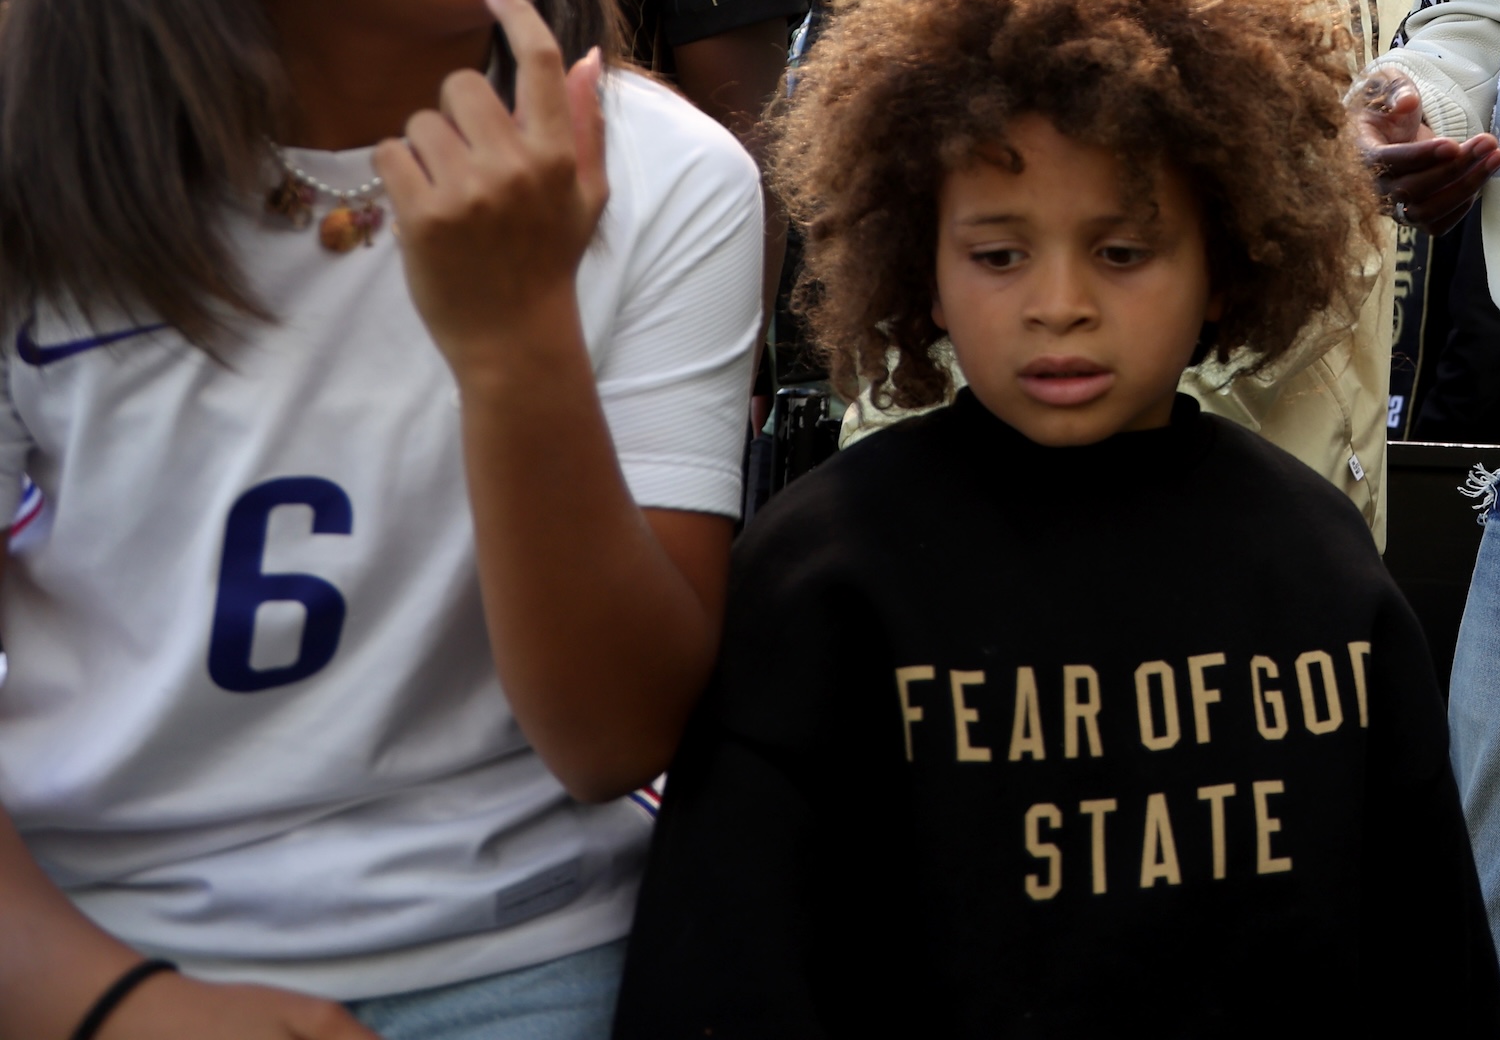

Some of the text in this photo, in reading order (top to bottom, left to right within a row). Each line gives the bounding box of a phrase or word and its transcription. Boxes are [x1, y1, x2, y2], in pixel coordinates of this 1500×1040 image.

[207, 475, 353, 693] 6
[895, 663, 1103, 762] FEAR
[1134, 651, 1226, 750] OF
[1024, 778, 1293, 901] STATE
